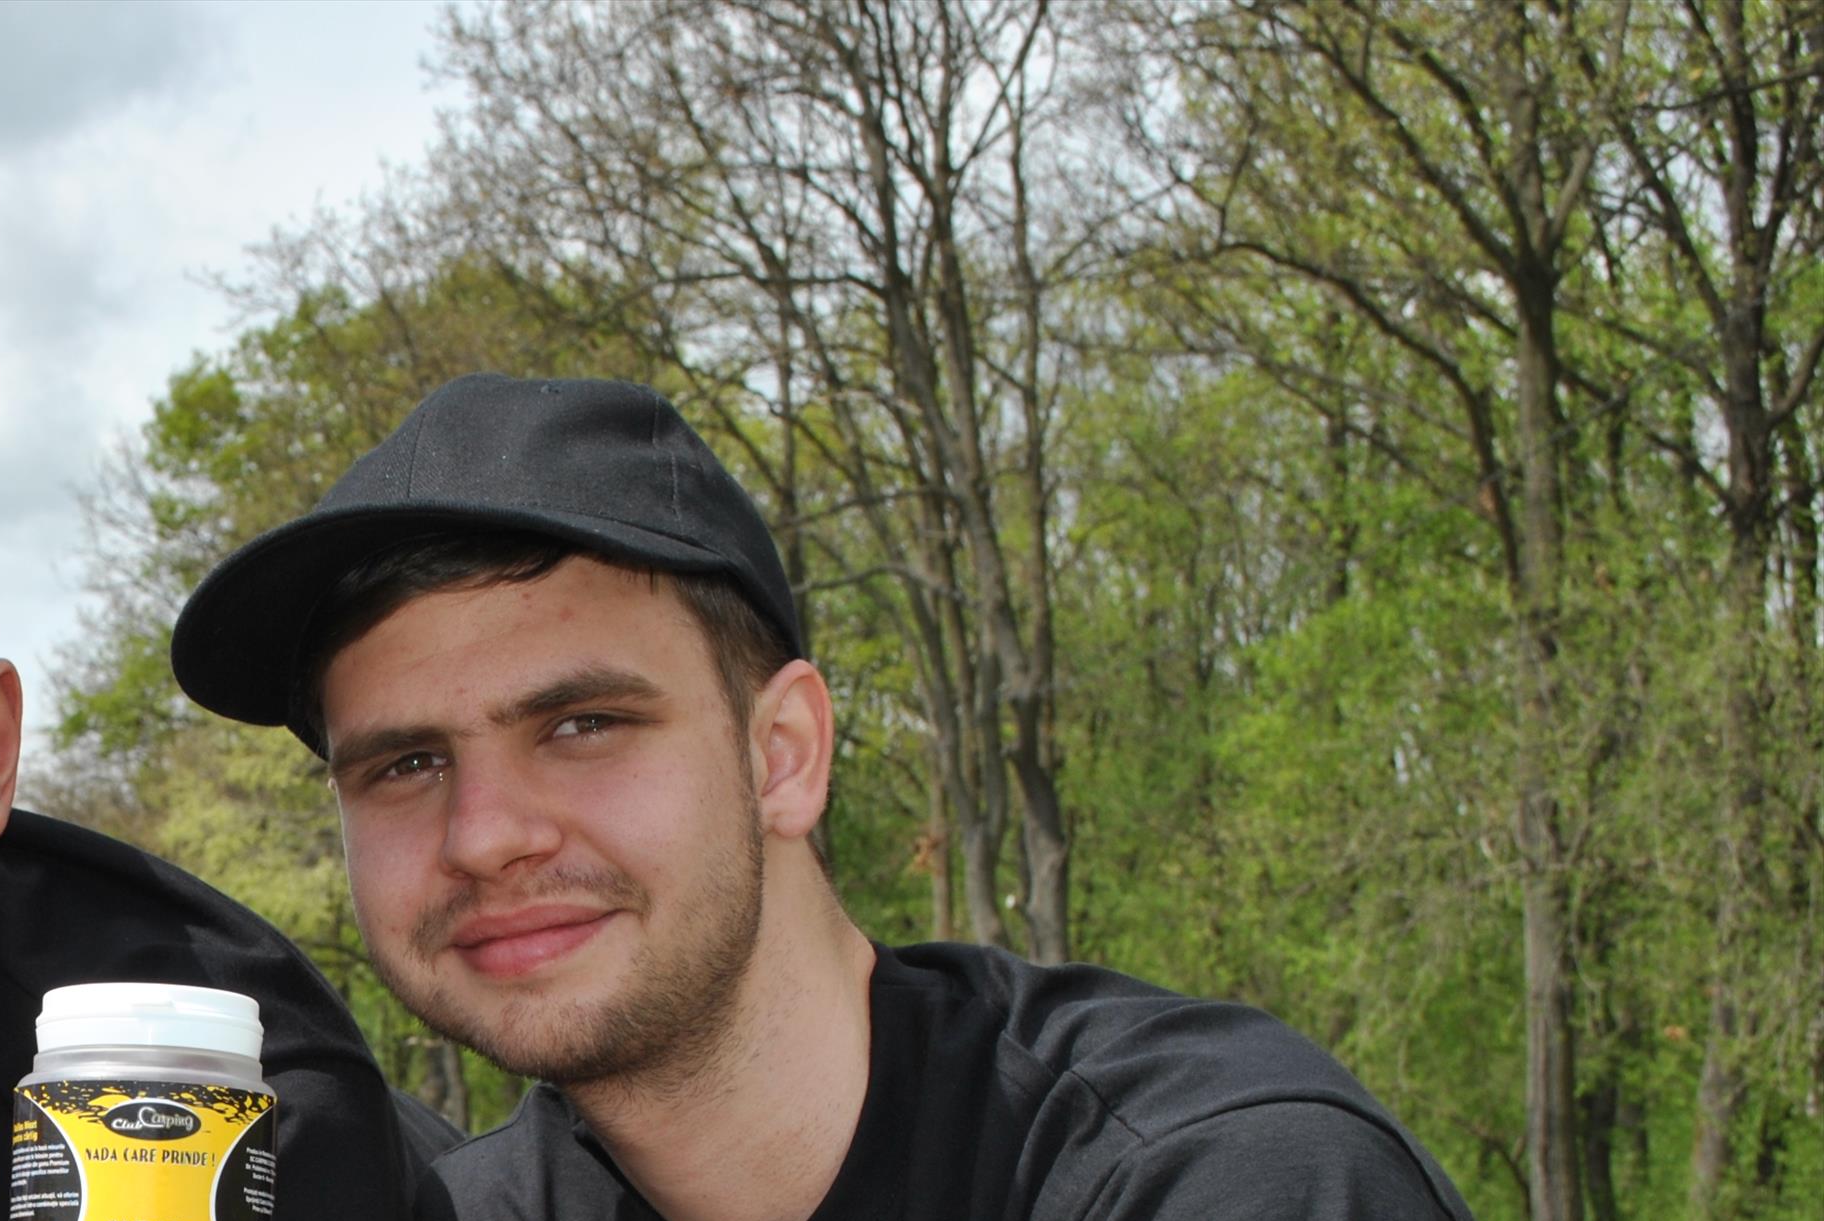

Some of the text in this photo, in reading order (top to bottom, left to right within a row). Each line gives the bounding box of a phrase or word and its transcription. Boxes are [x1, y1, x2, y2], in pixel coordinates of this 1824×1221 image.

[111, 1118, 143, 1130] Club
[85, 1147, 117, 1161] NADA
[123, 1148, 156, 1163] CARE
[162, 1149, 208, 1166] PRINDE
